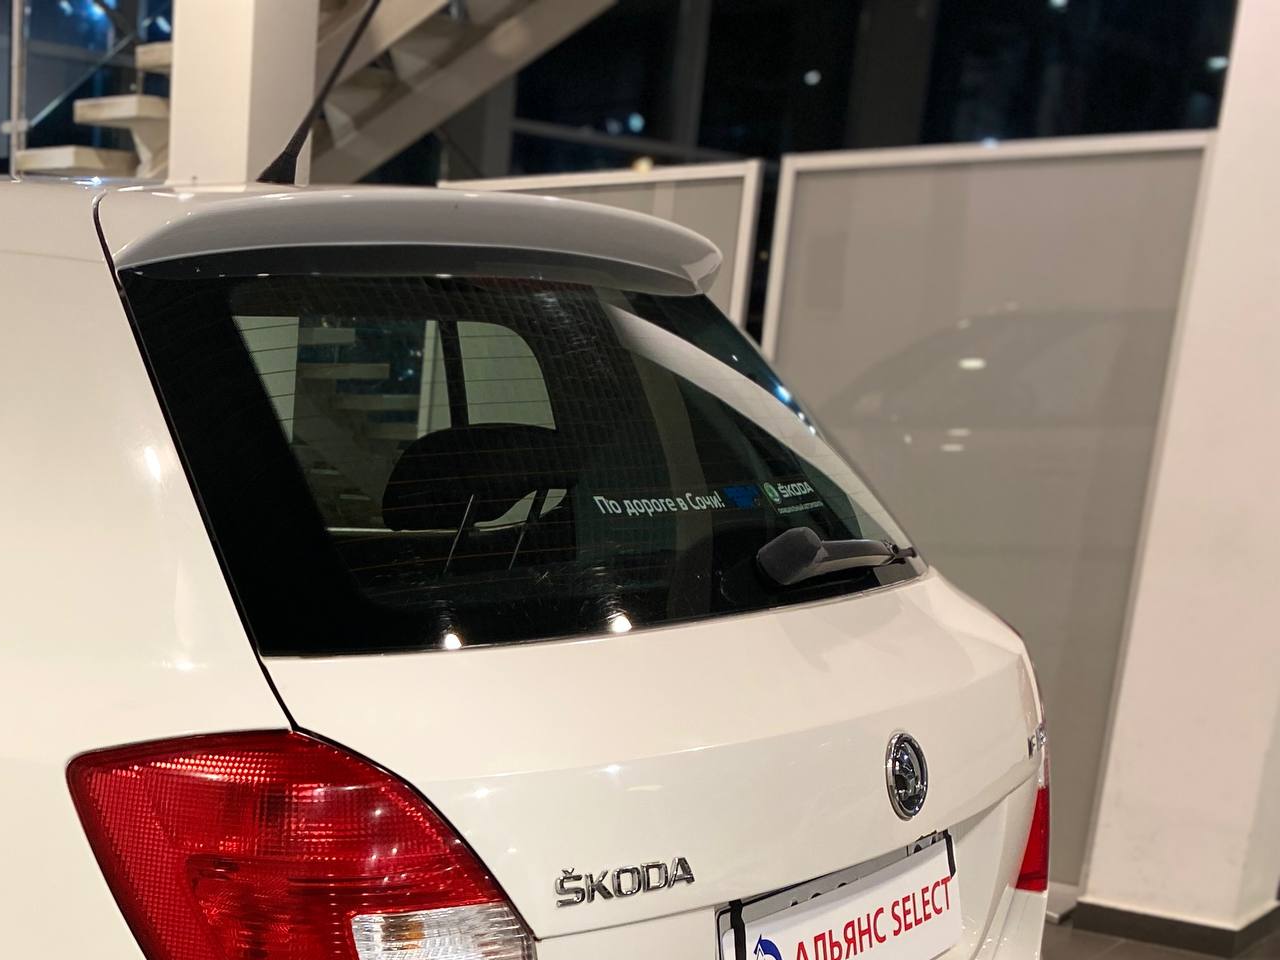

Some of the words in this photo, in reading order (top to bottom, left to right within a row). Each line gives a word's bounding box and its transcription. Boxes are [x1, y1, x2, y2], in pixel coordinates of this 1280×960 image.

[593, 495, 622, 514] По
[623, 498, 677, 517] дороге
[676, 497, 688, 511] в
[685, 491, 725, 509] Сочи!
[777, 482, 814, 498] ŠKODA
[554, 856, 695, 908] ŠKODA
[891, 876, 952, 938] SELECT
